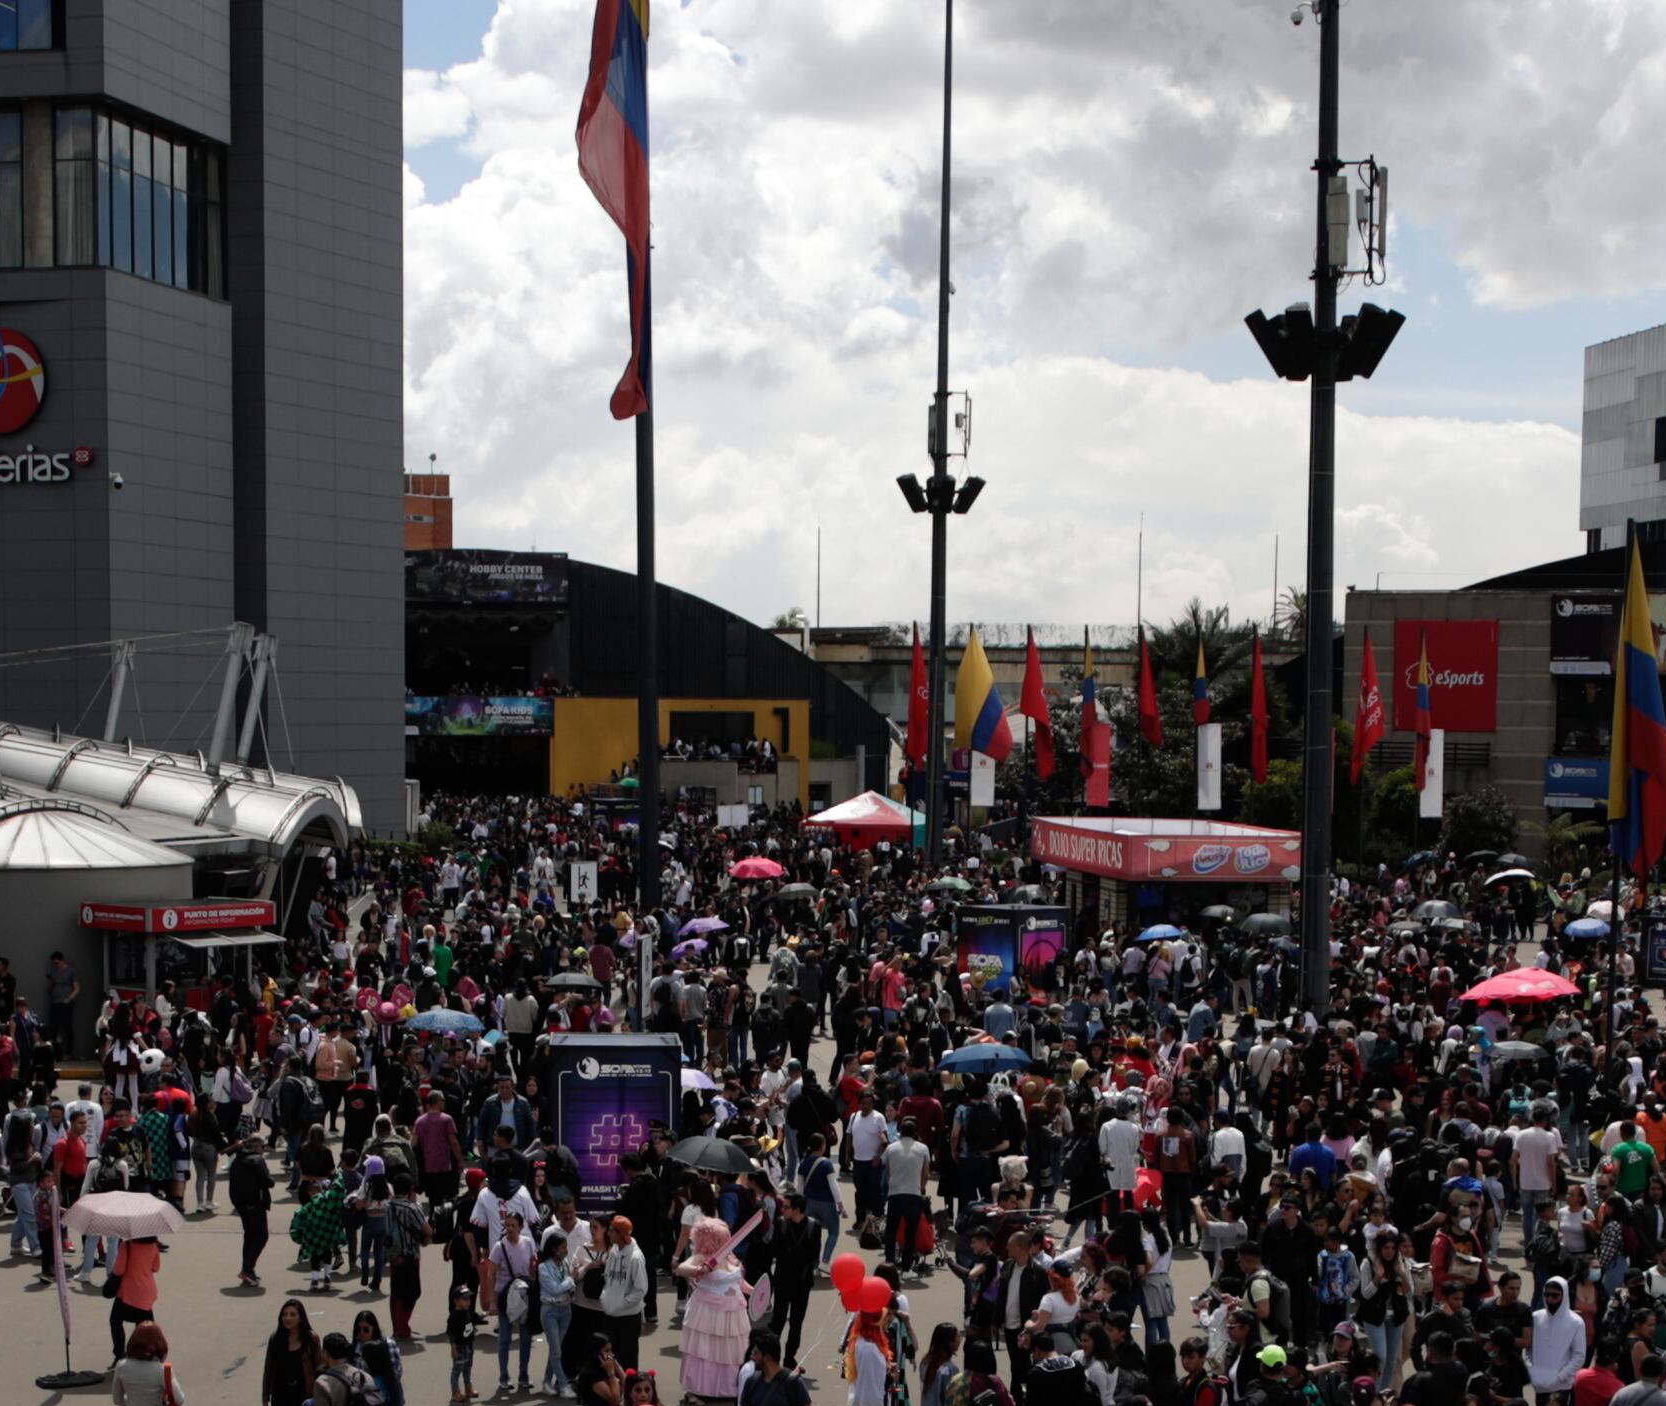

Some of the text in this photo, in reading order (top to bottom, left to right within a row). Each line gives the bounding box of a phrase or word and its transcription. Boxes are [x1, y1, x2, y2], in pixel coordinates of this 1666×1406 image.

[469, 564, 543, 574] HOBBY CENTER
[1435, 669, 1485, 689] eSports
[1049, 829, 1123, 870] DOJO SUPER RICAS
[183, 911, 208, 919] PUNTO
[966, 953, 1004, 968] SOFA
[600, 1064, 635, 1074] SOFA
